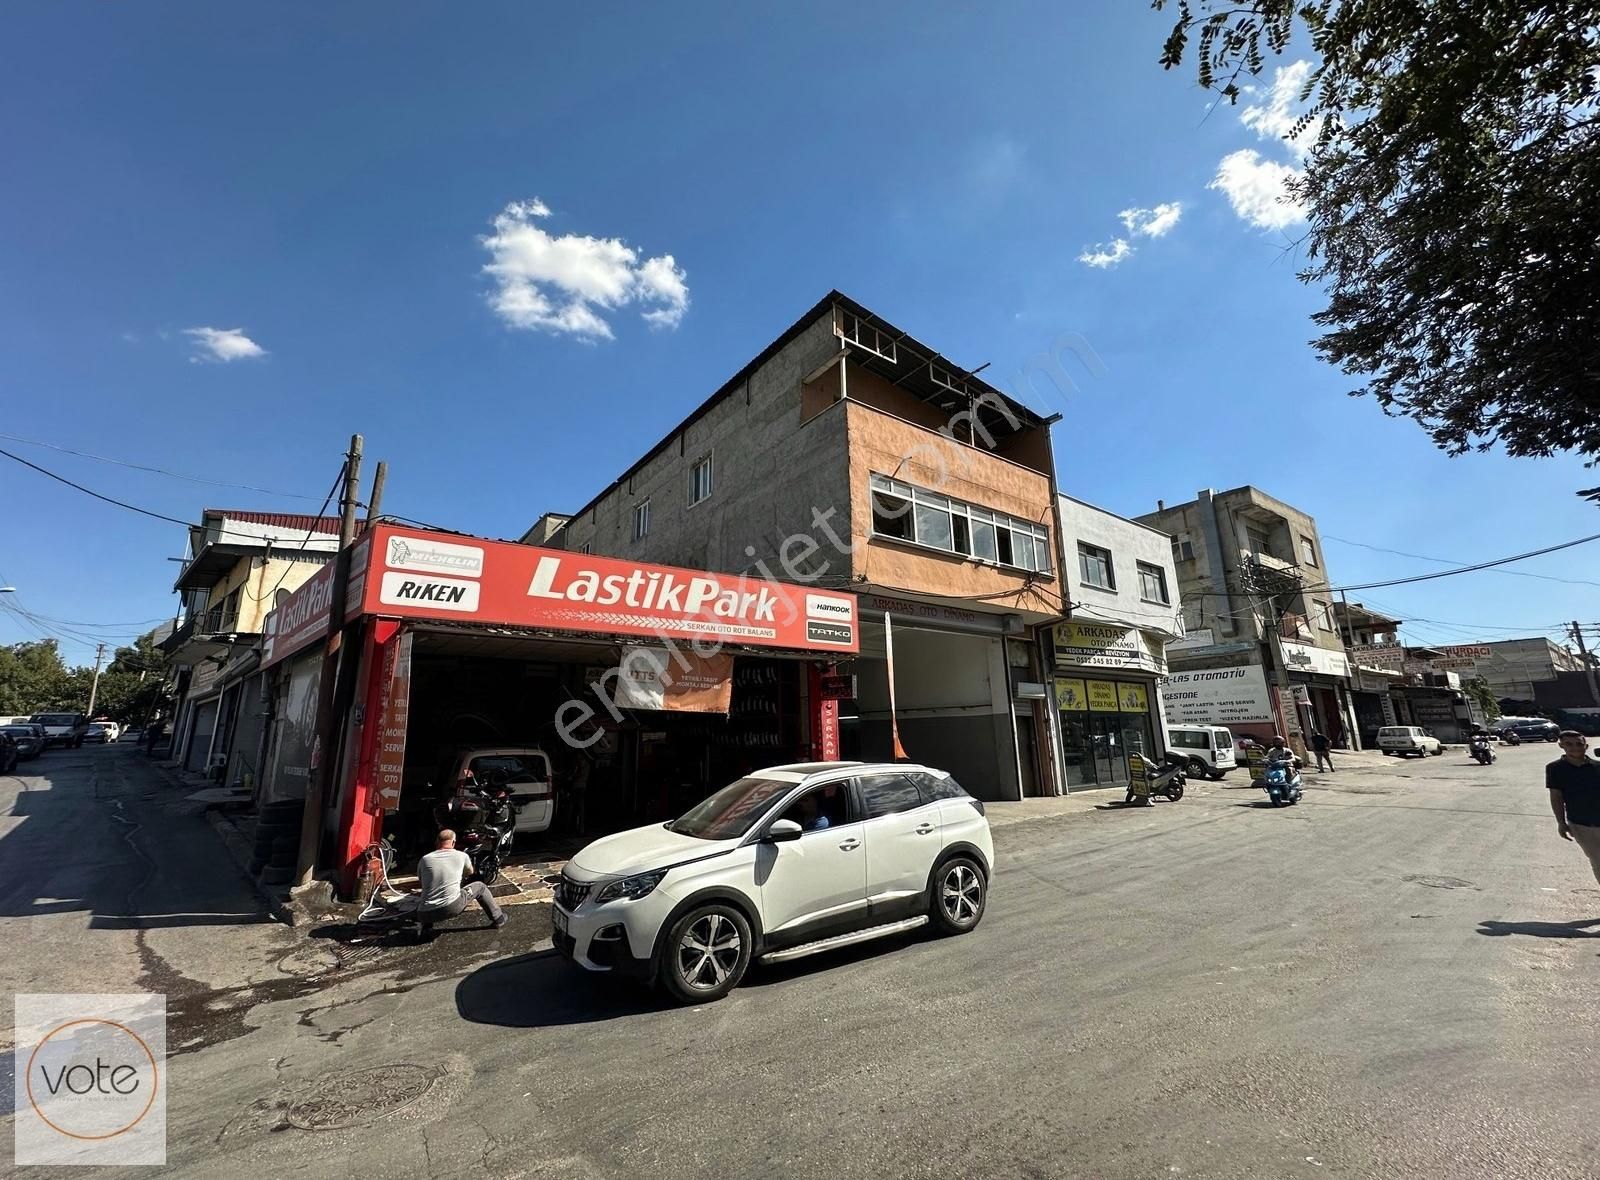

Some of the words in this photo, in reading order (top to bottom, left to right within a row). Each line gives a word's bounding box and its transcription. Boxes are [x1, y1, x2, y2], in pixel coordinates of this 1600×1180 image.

[410, 552, 479, 569] MICHELIN
[920, 606, 937, 617] OTO
[687, 622, 716, 632] SERKAN
[717, 625, 731, 633] OTO
[732, 627, 746, 635] ROT
[747, 628, 773, 637] BALANS
[809, 627, 851, 638] TATKO
[1076, 626, 1126, 641] ARKADAŞ
[1090, 639, 1106, 647] OTO
[1107, 639, 1135, 649] DİNAMO
[1083, 649, 1101, 657] PARÇA
[1092, 657, 1105, 665] 345
[825, 710, 834, 755] SERKAN
[384, 774, 398, 783] OTO
